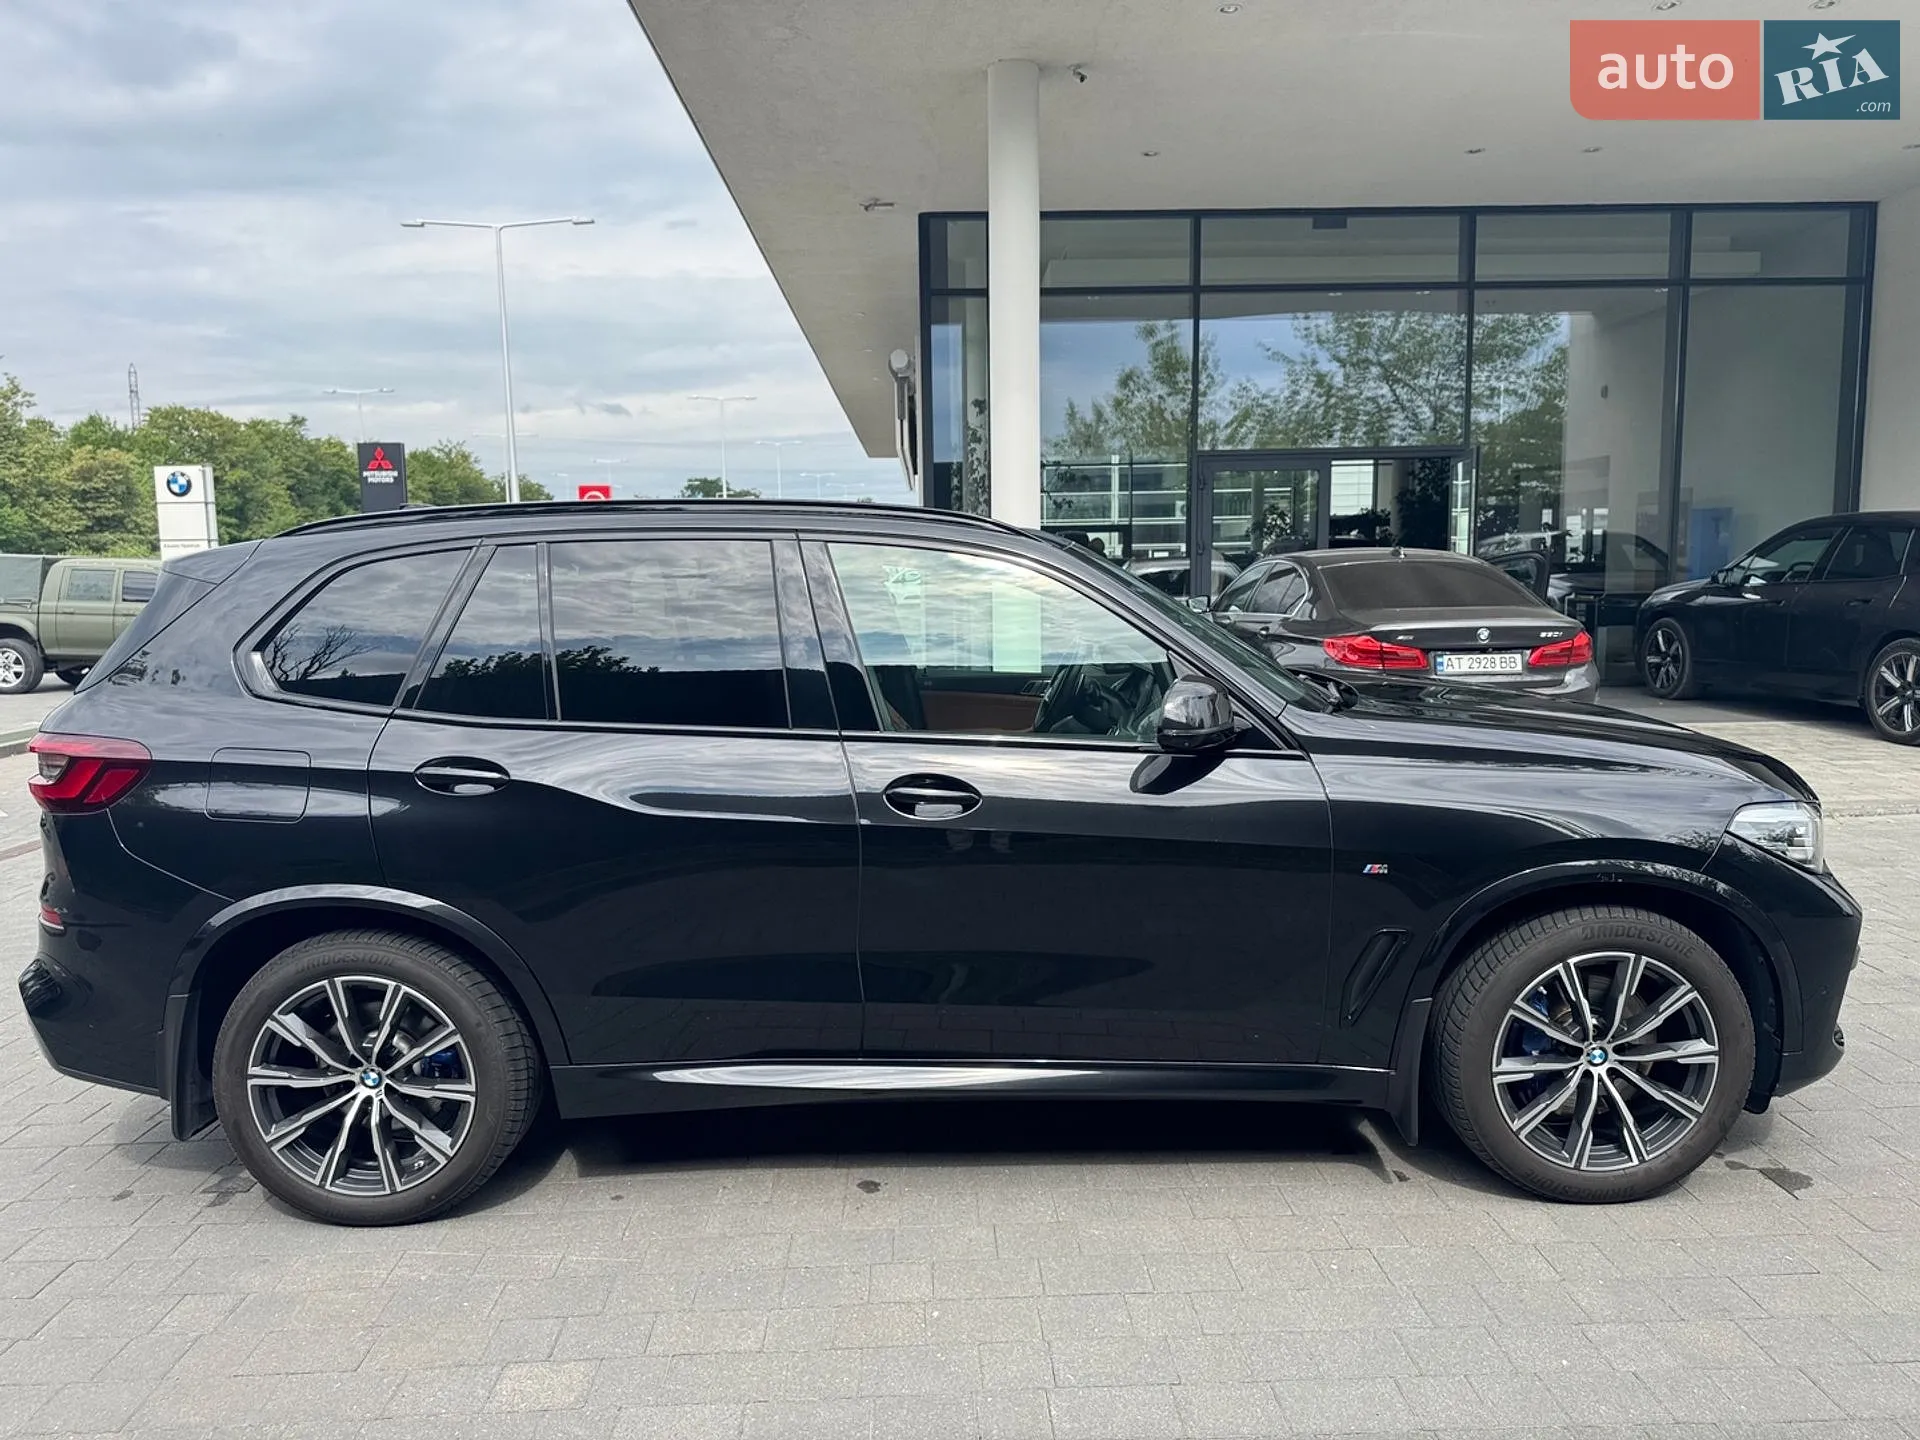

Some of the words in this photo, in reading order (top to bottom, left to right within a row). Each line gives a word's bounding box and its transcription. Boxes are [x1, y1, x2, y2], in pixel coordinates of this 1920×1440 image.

[1445, 657, 1464, 670] AT
[1467, 656, 1497, 669] 2928
[1499, 656, 1518, 669] BB
[1580, 924, 1696, 958] BRIDGESTONE
